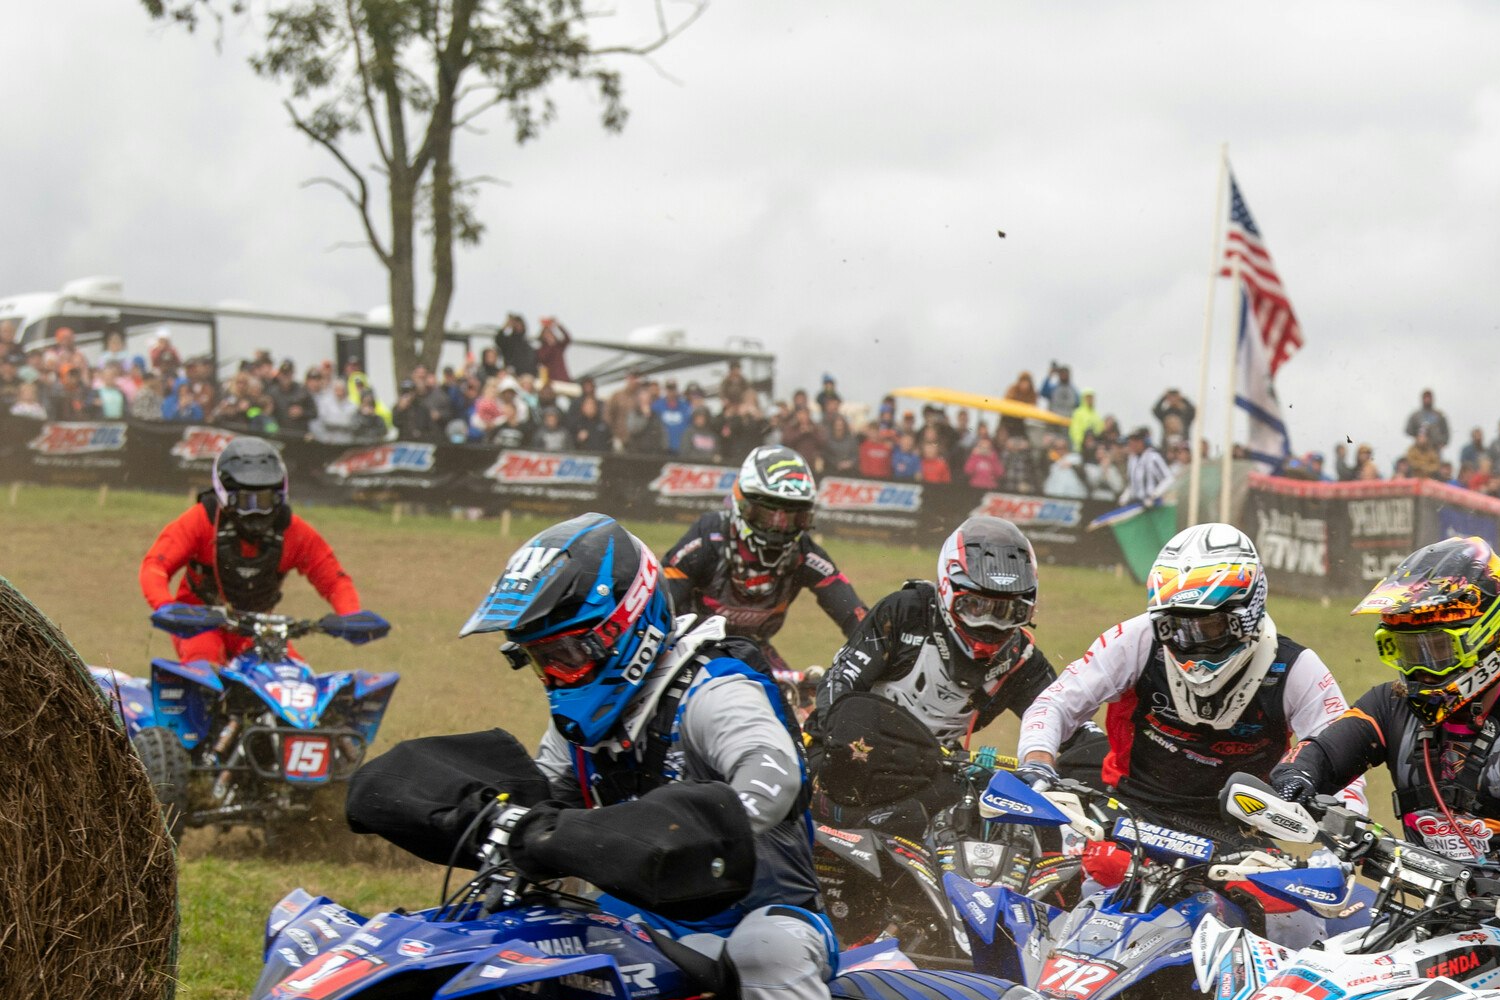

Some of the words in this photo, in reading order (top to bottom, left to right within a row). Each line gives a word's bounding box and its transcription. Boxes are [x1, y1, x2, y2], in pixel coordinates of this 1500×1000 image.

[39, 423, 127, 450] AMSOIL
[335, 443, 435, 475] AMSOIL
[496, 452, 599, 483] AMSOIL
[819, 478, 922, 512] AMSOIL
[976, 495, 1082, 527] AMSOIL
[626, 628, 664, 683] 001
[1459, 656, 1500, 697] 733
[286, 740, 328, 773] 15
[1285, 883, 1338, 901] ACERBIS
[1041, 957, 1105, 996] 712
[1425, 951, 1481, 980] KENDA
